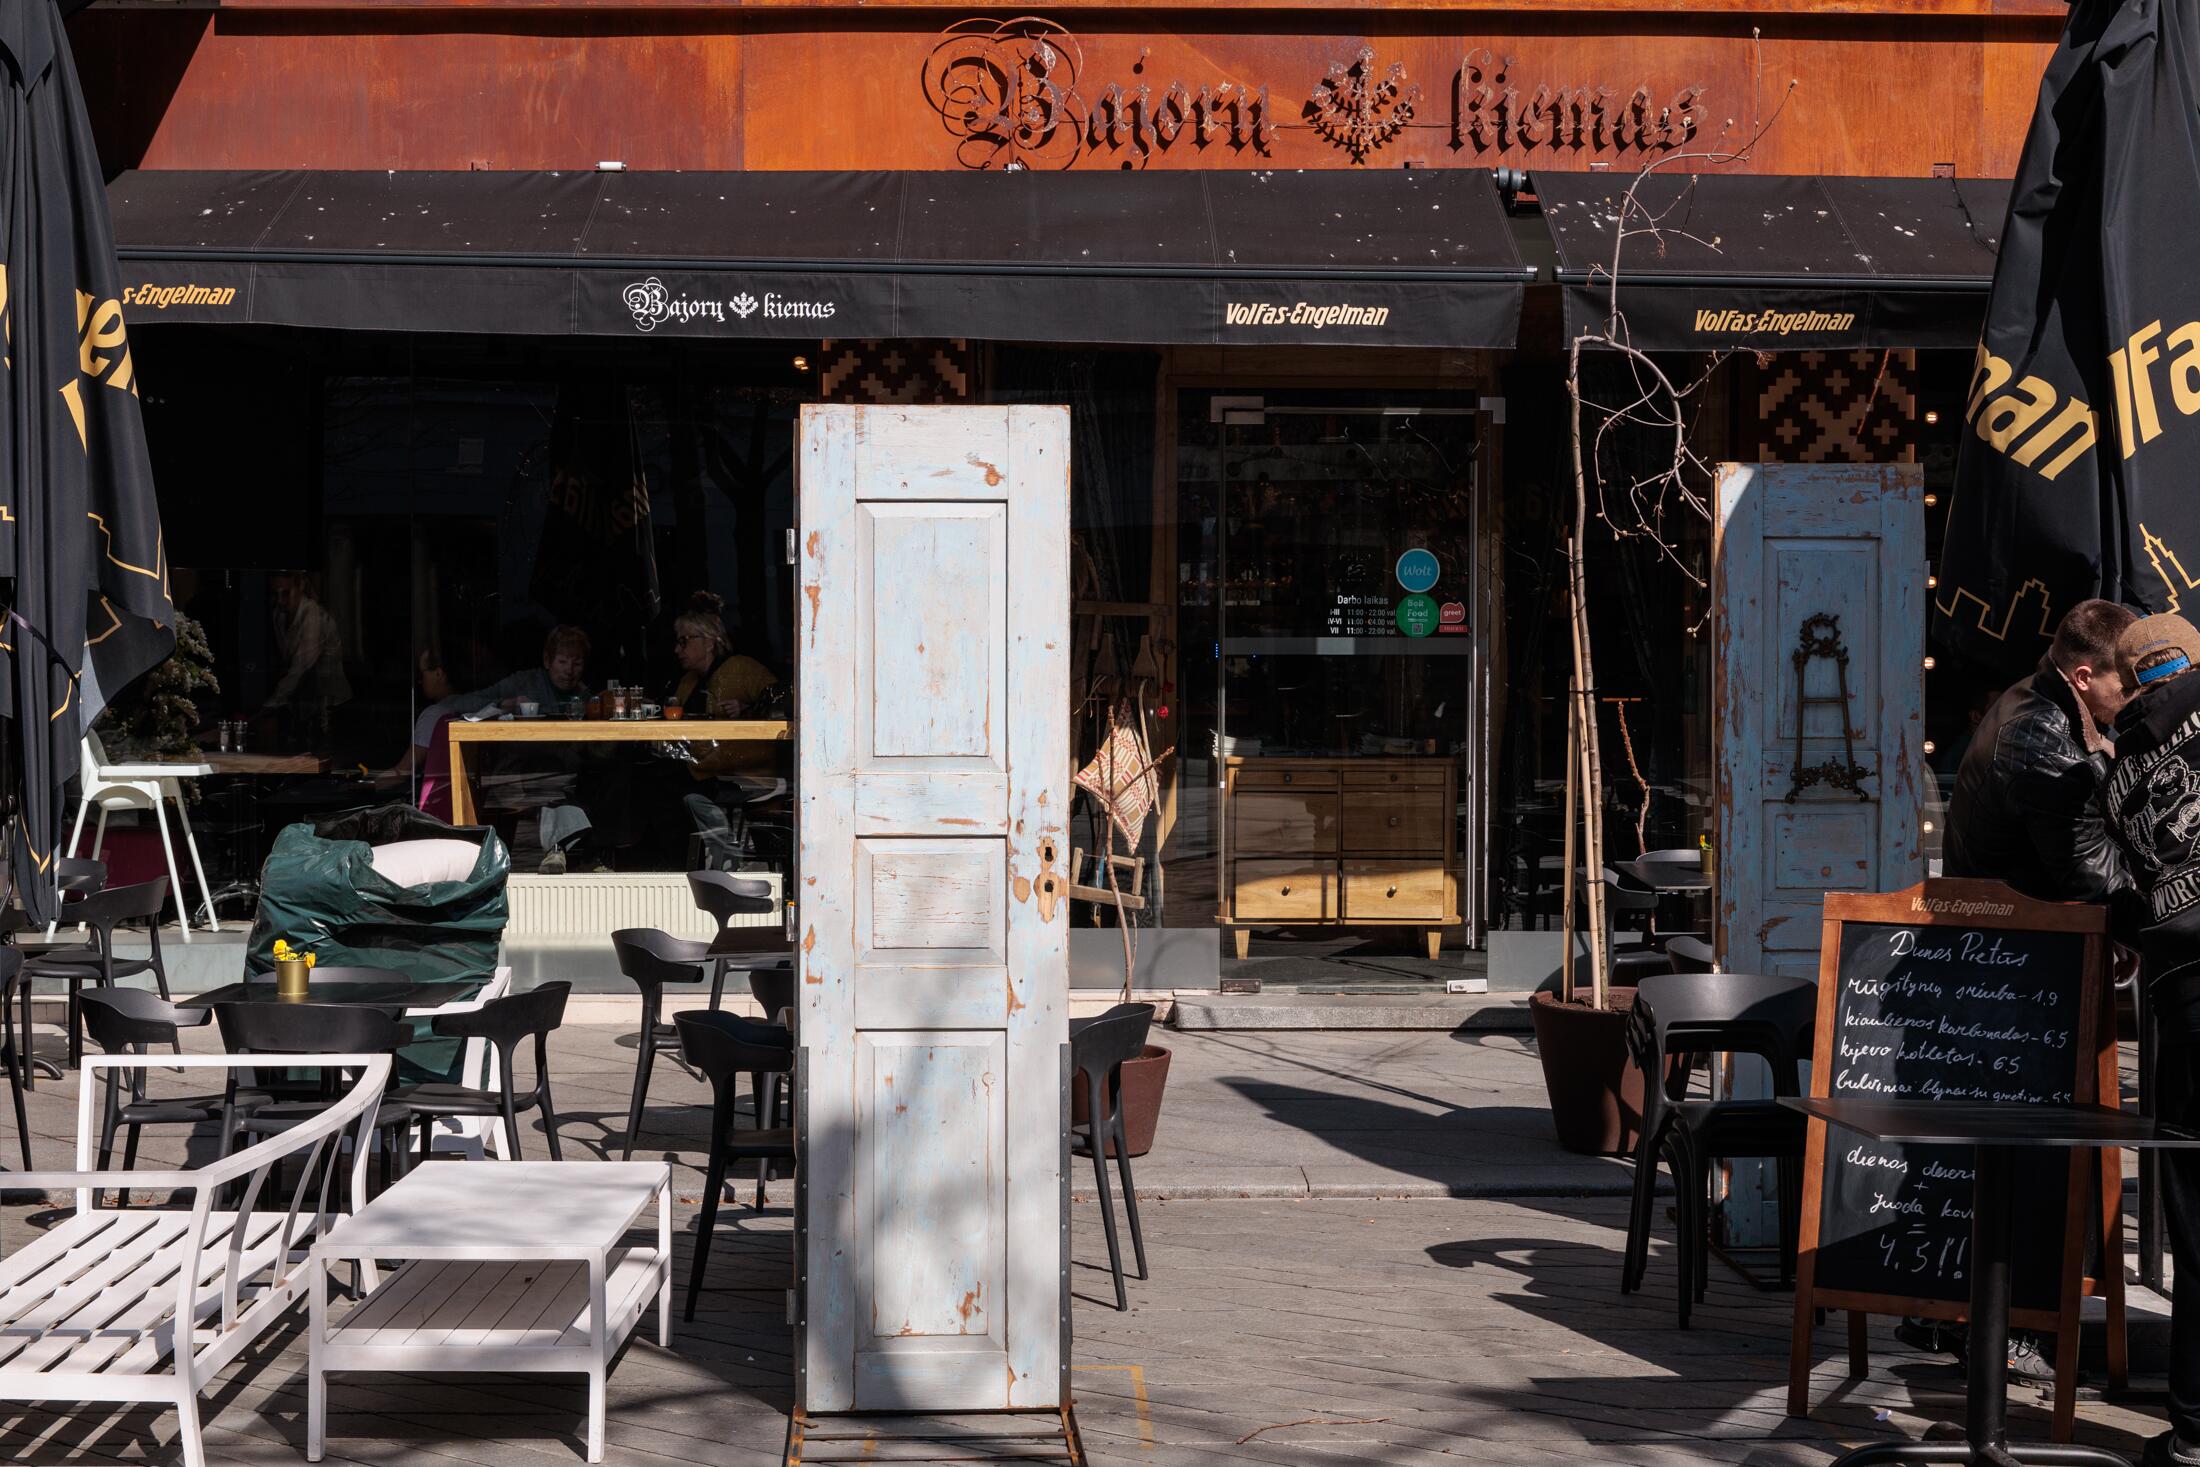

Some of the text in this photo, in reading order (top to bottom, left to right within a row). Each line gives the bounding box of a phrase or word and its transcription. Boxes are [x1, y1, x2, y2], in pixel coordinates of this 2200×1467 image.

[1447, 47, 1708, 158] kiemas
[764, 292, 836, 320] kiemas
[1404, 565, 1432, 576] Wolt
[1337, 595, 1389, 605] Darbo laikas
[1407, 609, 1428, 617] Food
[1443, 609, 1462, 617] greet
[1330, 627, 1339, 635] VII
[1847, 1146, 1908, 1173] dienos
